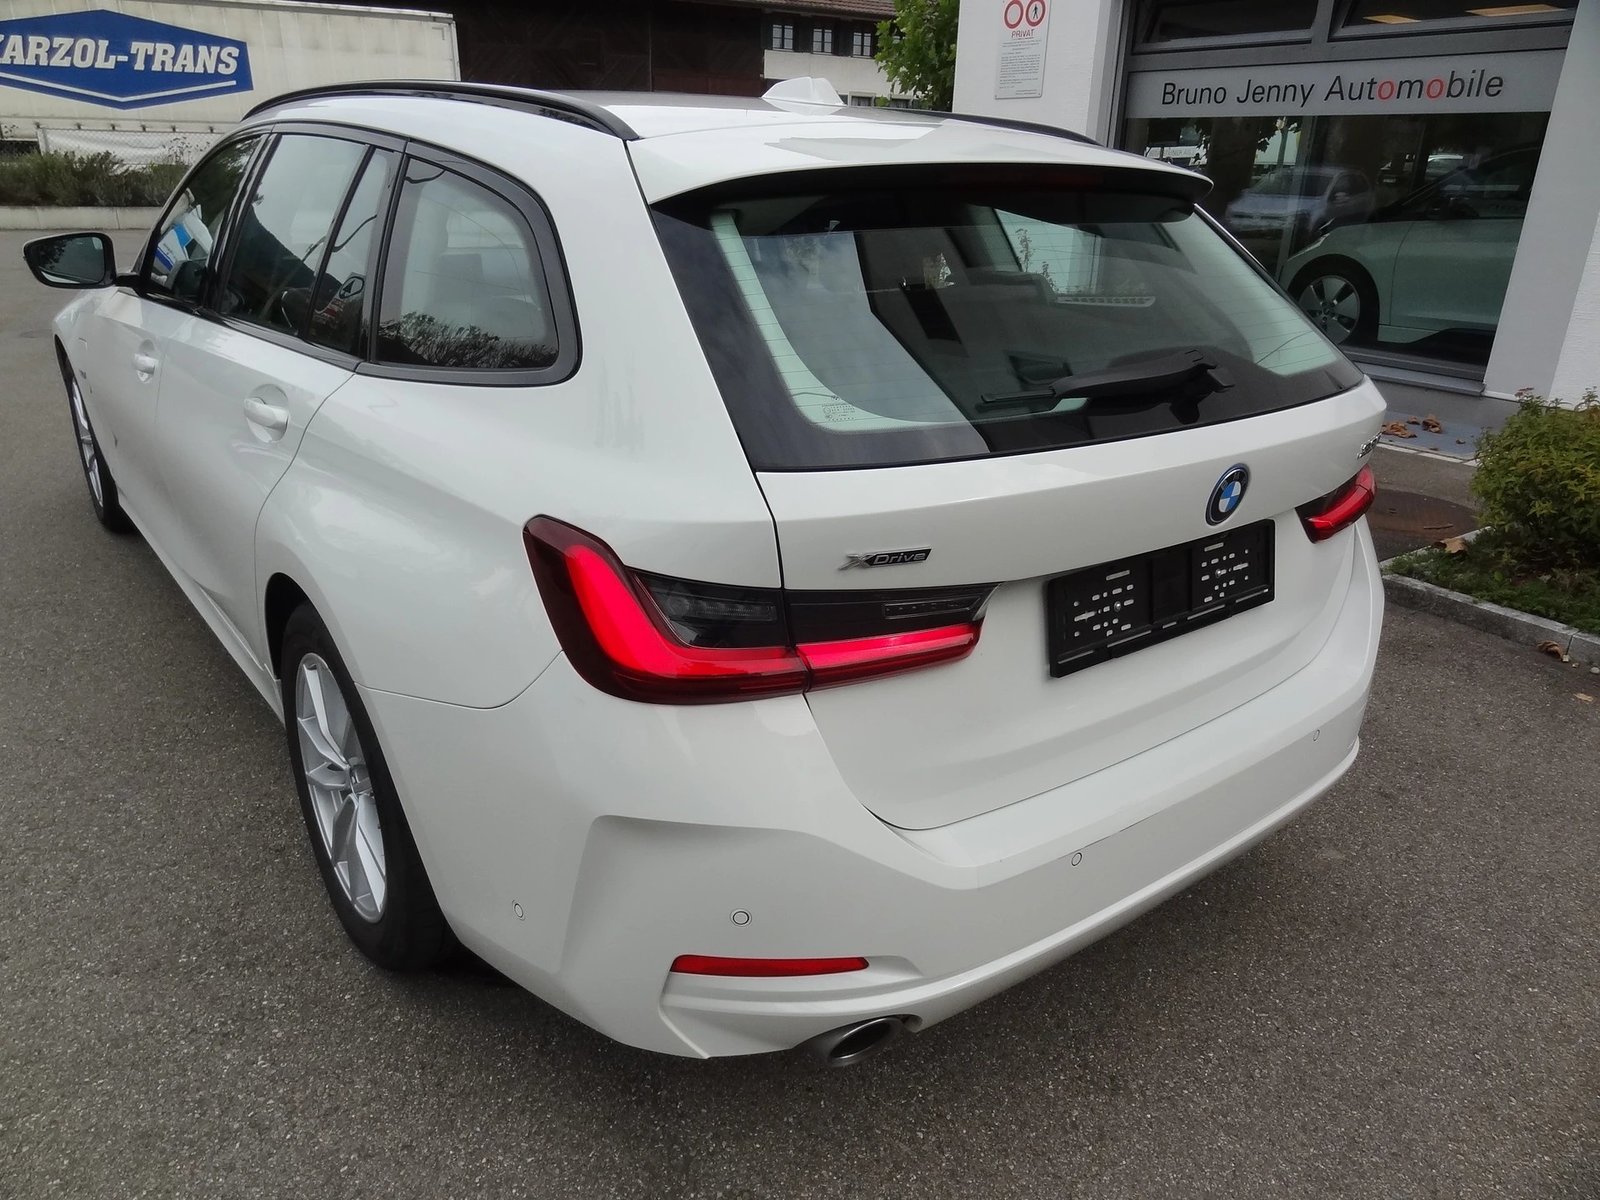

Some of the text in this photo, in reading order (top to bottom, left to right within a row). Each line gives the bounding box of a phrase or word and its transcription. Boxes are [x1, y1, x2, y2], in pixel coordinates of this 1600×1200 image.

[1011, 29, 1035, 38] PRIVAT
[1161, 69, 1504, 107] Bruno Jenny Automobile
